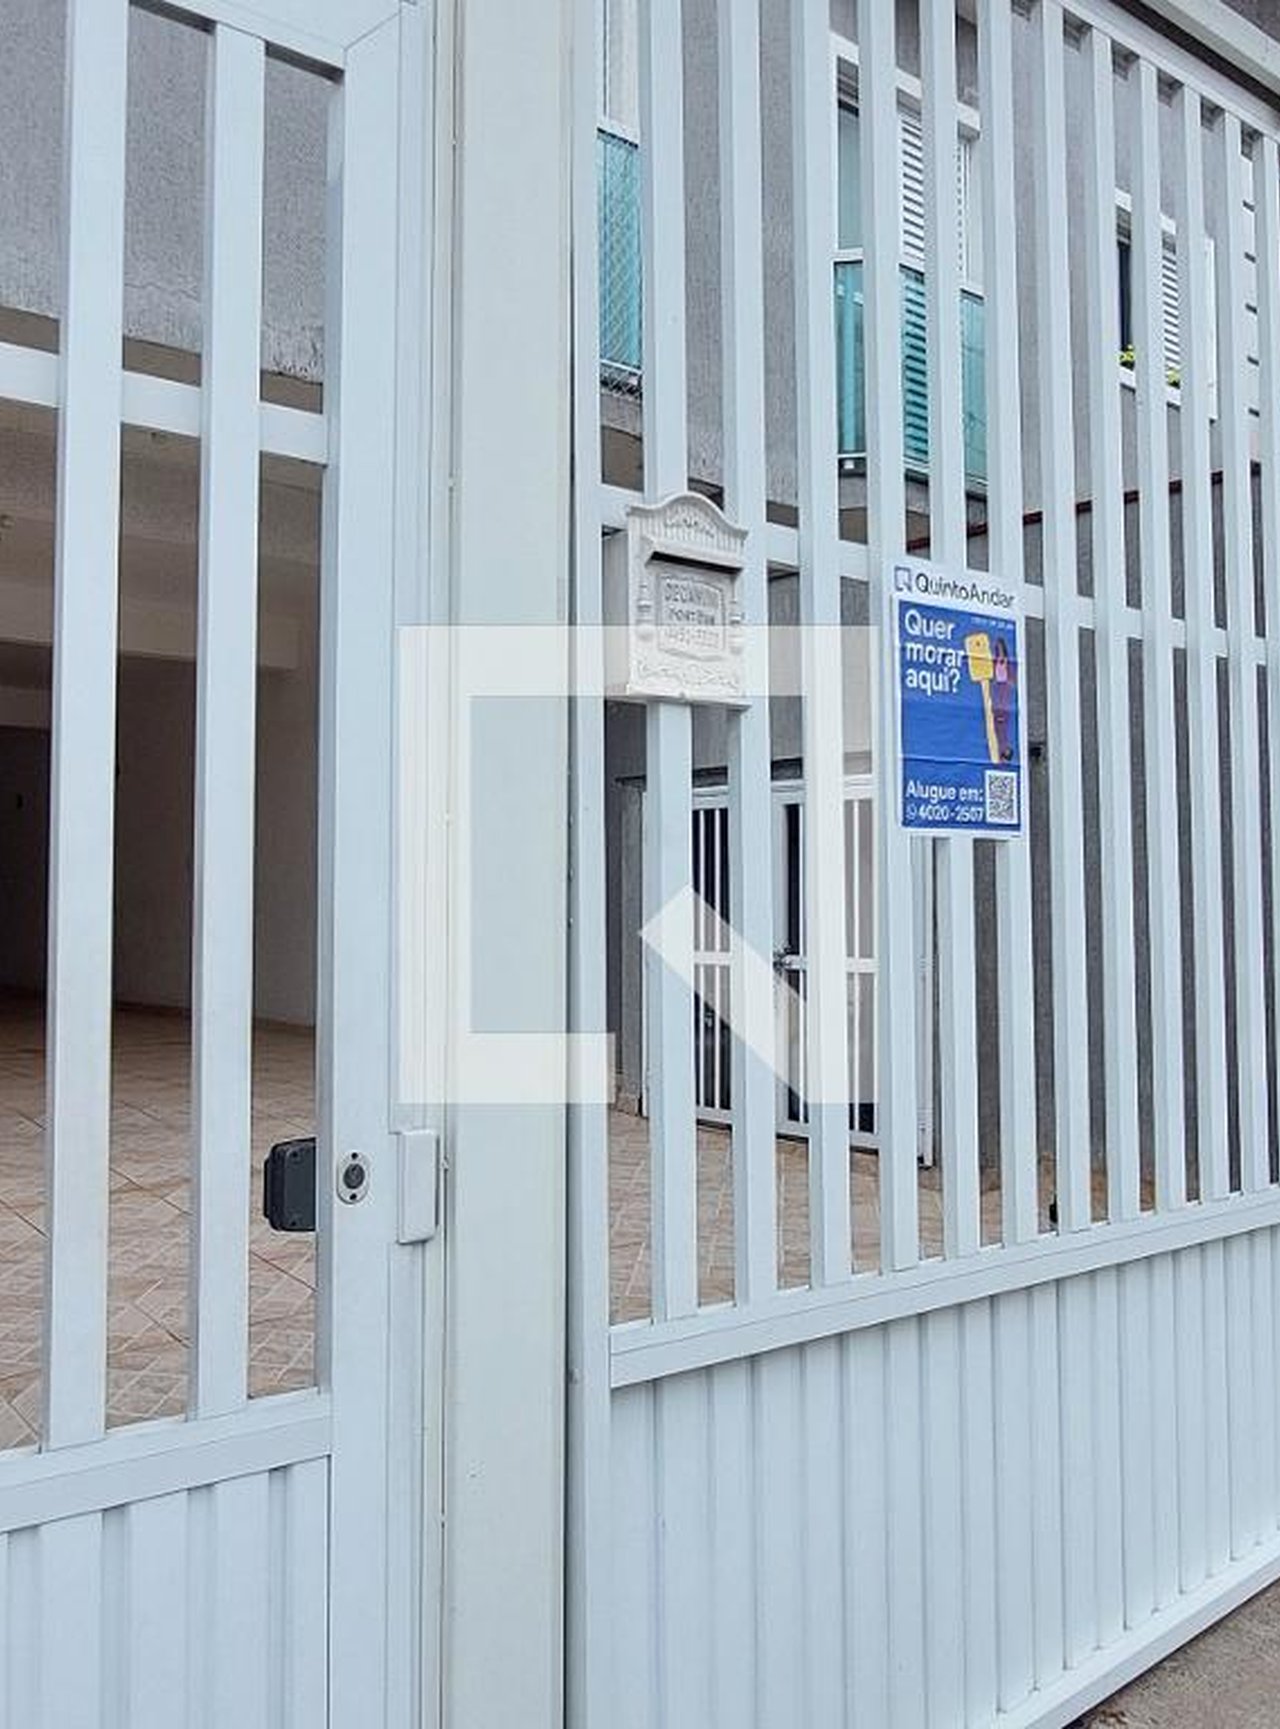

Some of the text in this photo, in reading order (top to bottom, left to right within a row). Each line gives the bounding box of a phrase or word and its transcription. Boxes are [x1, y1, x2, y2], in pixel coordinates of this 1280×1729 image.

[915, 573, 1015, 608] QuintoAndar
[904, 608, 955, 641] Quer
[905, 642, 965, 668] morar
[905, 667, 961, 697] aqui?
[905, 779, 984, 804] Alugue em:
